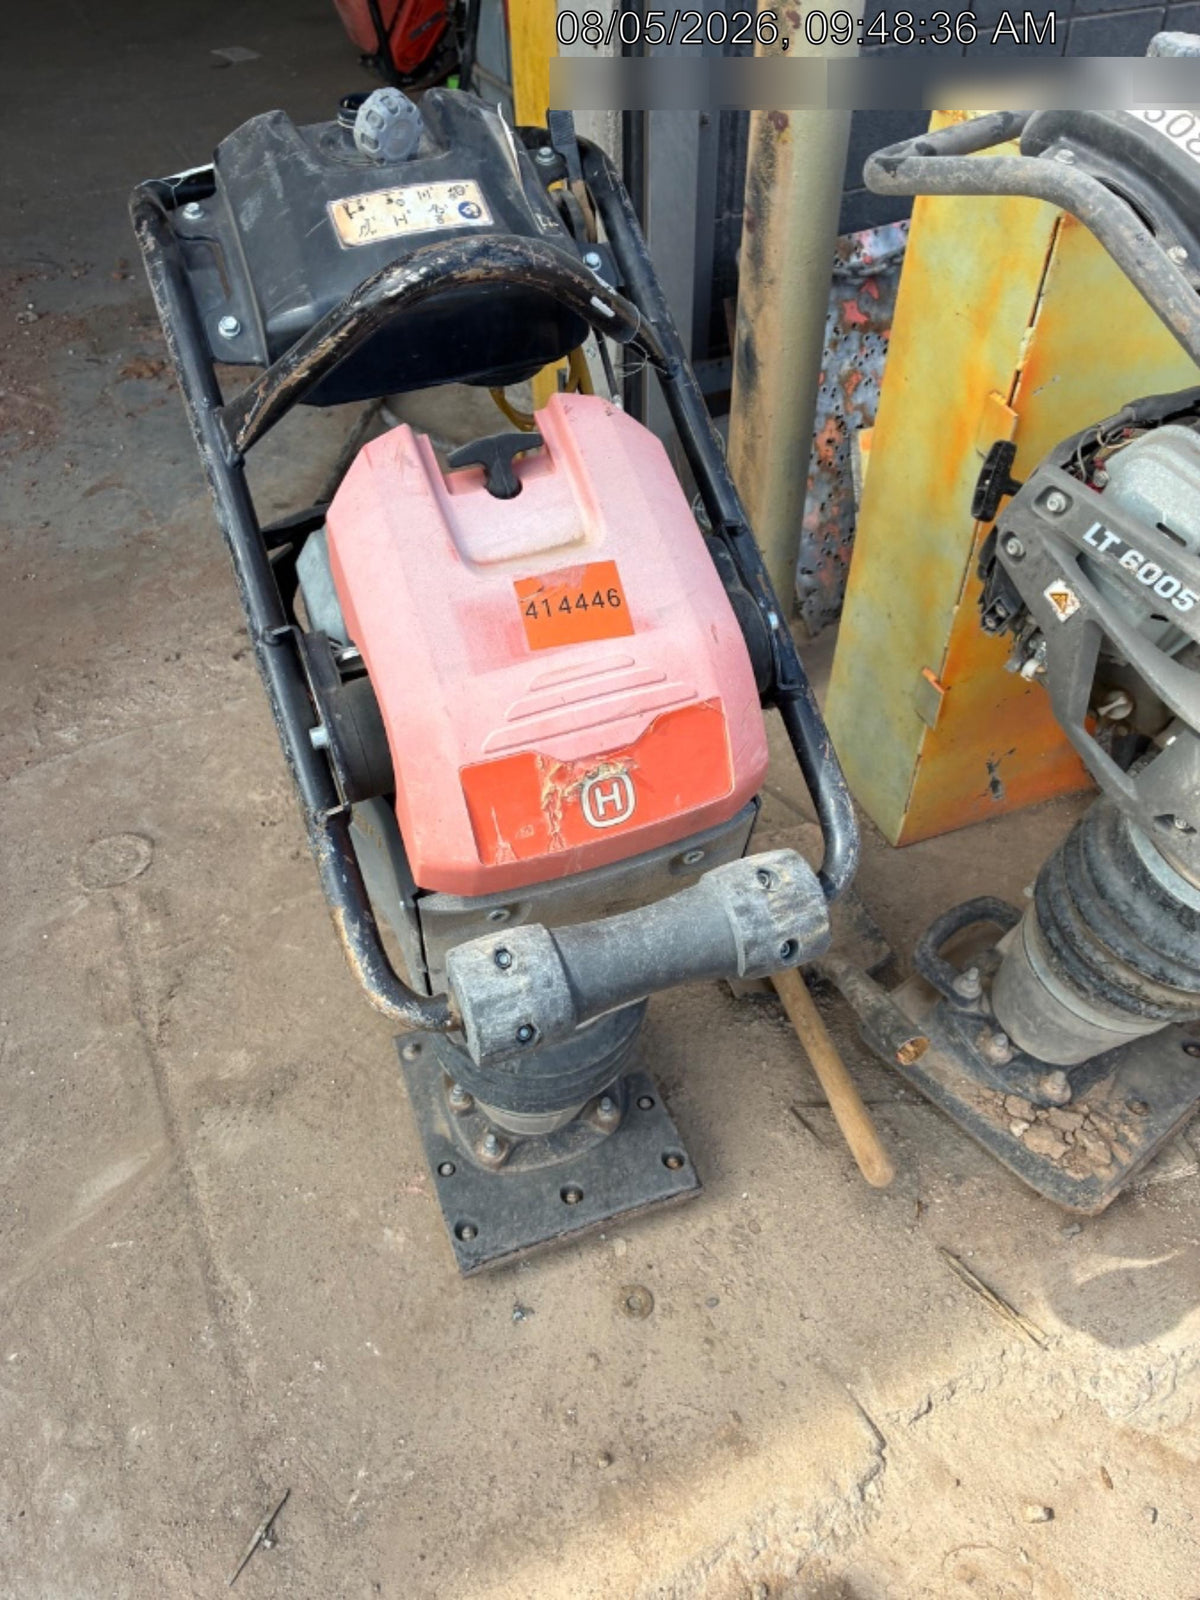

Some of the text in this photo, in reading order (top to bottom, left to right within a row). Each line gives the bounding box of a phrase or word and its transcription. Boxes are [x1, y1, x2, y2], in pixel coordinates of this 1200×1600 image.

[1082, 521, 1200, 612] LT 6005
[525, 587, 621, 620] 414446
